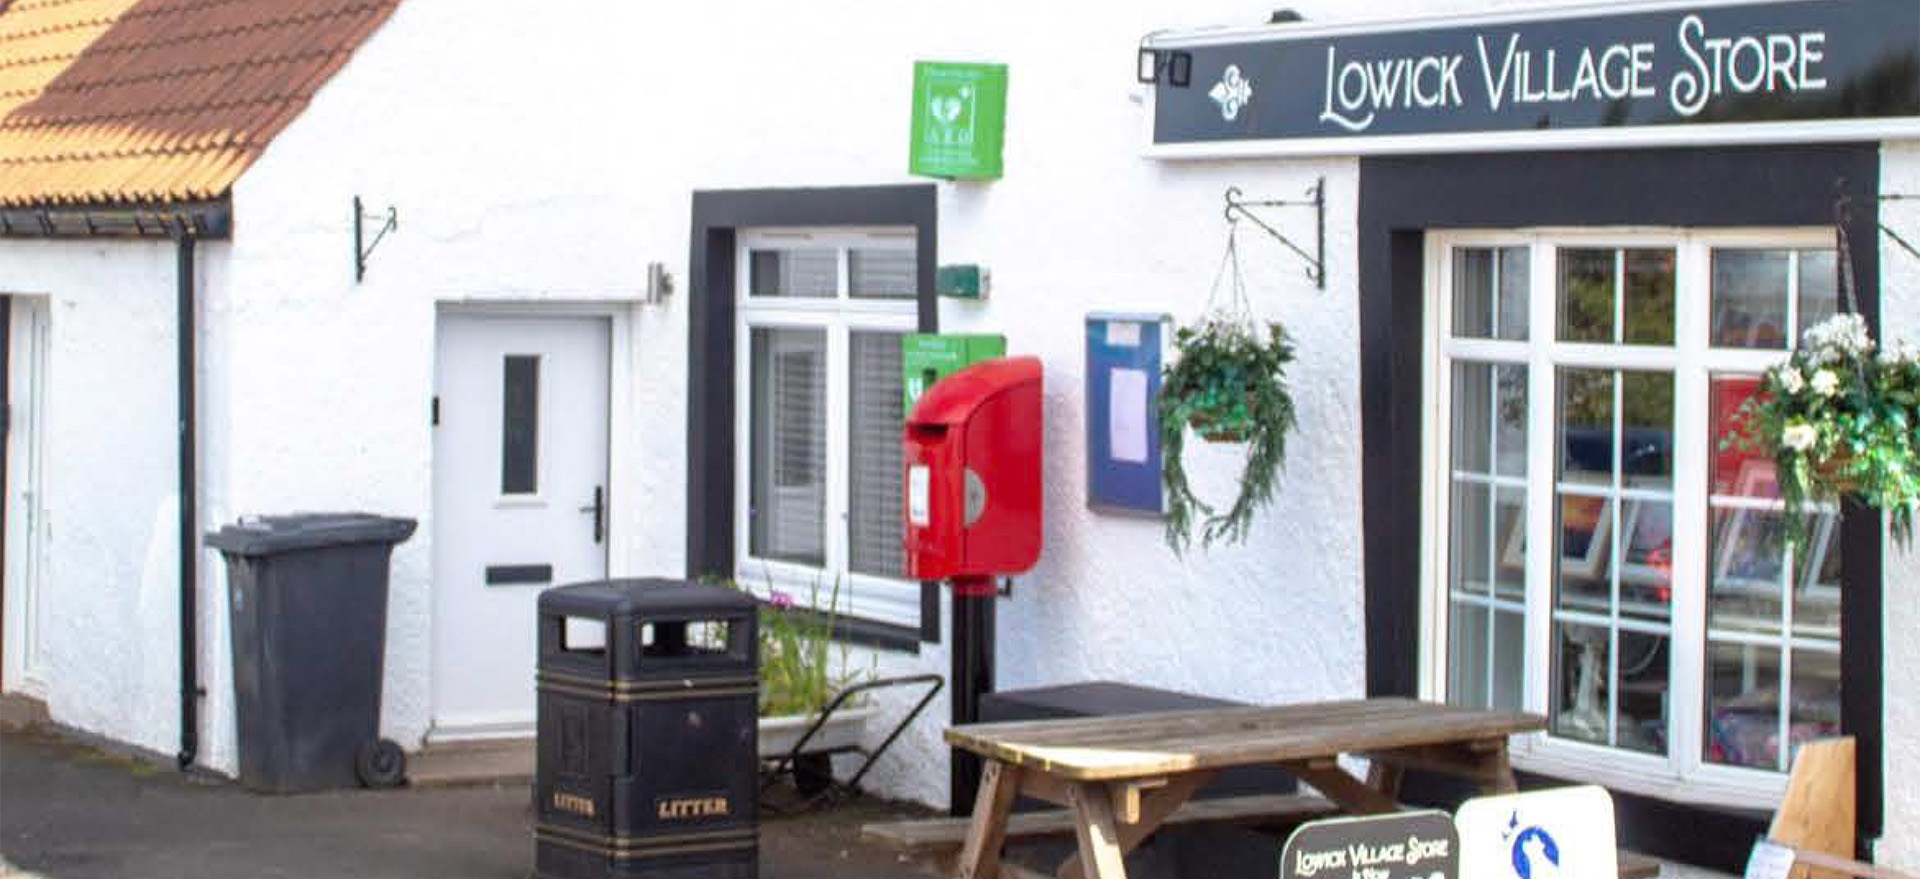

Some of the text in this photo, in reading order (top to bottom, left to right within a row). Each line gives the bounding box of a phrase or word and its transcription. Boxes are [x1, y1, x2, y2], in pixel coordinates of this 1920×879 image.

[1319, 14, 1827, 131] LOWICK VILLAGE STORE
[658, 798, 727, 819] LITTER
[1295, 834, 1449, 877] LOWICK VILLAGE STORE
